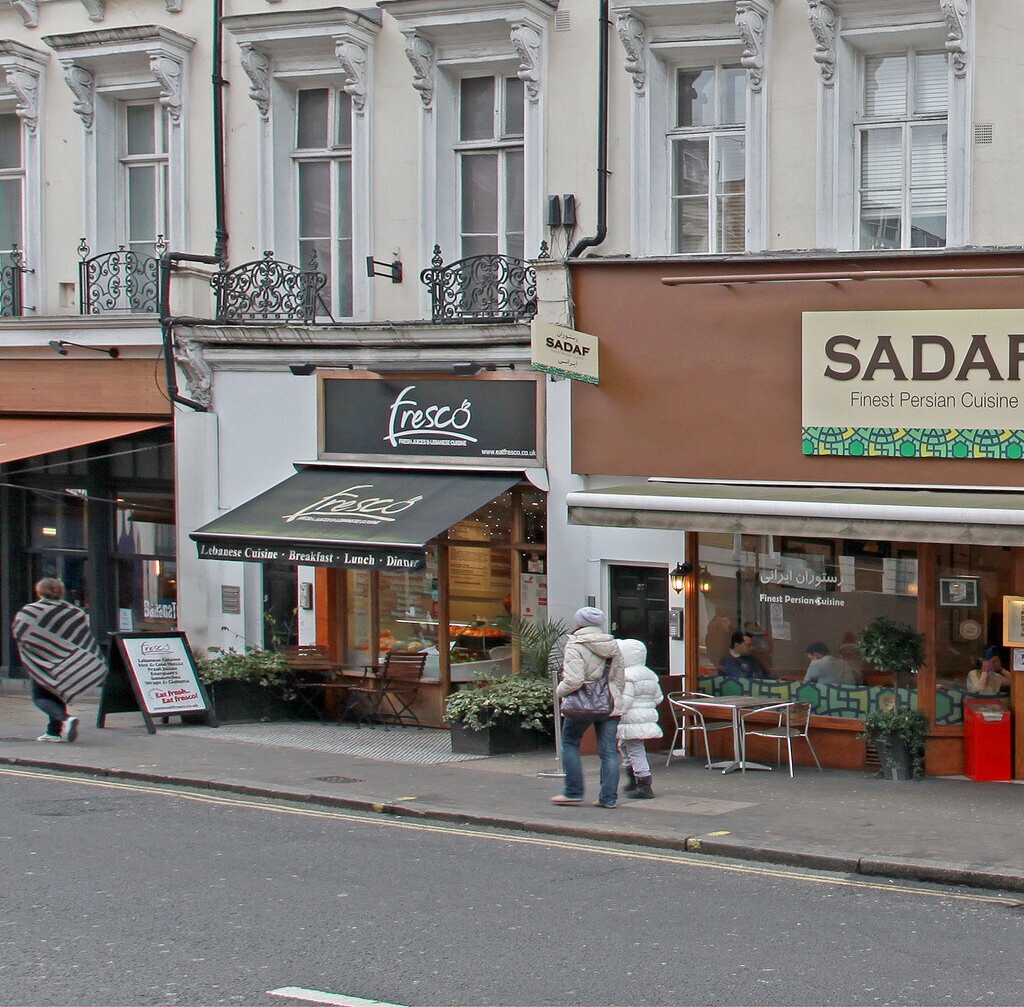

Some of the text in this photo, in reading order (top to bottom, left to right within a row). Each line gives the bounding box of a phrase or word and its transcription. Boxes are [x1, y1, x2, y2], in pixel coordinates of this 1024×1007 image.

[545, 336, 591, 356] SADAF
[850, 391, 1019, 409] Finest Persian Cuisine
[201, 544, 420, 568] Lebanese Cuisine Breakfast Lunch Dinner
[759, 594, 845, 606] Finest Persian Cuisine
